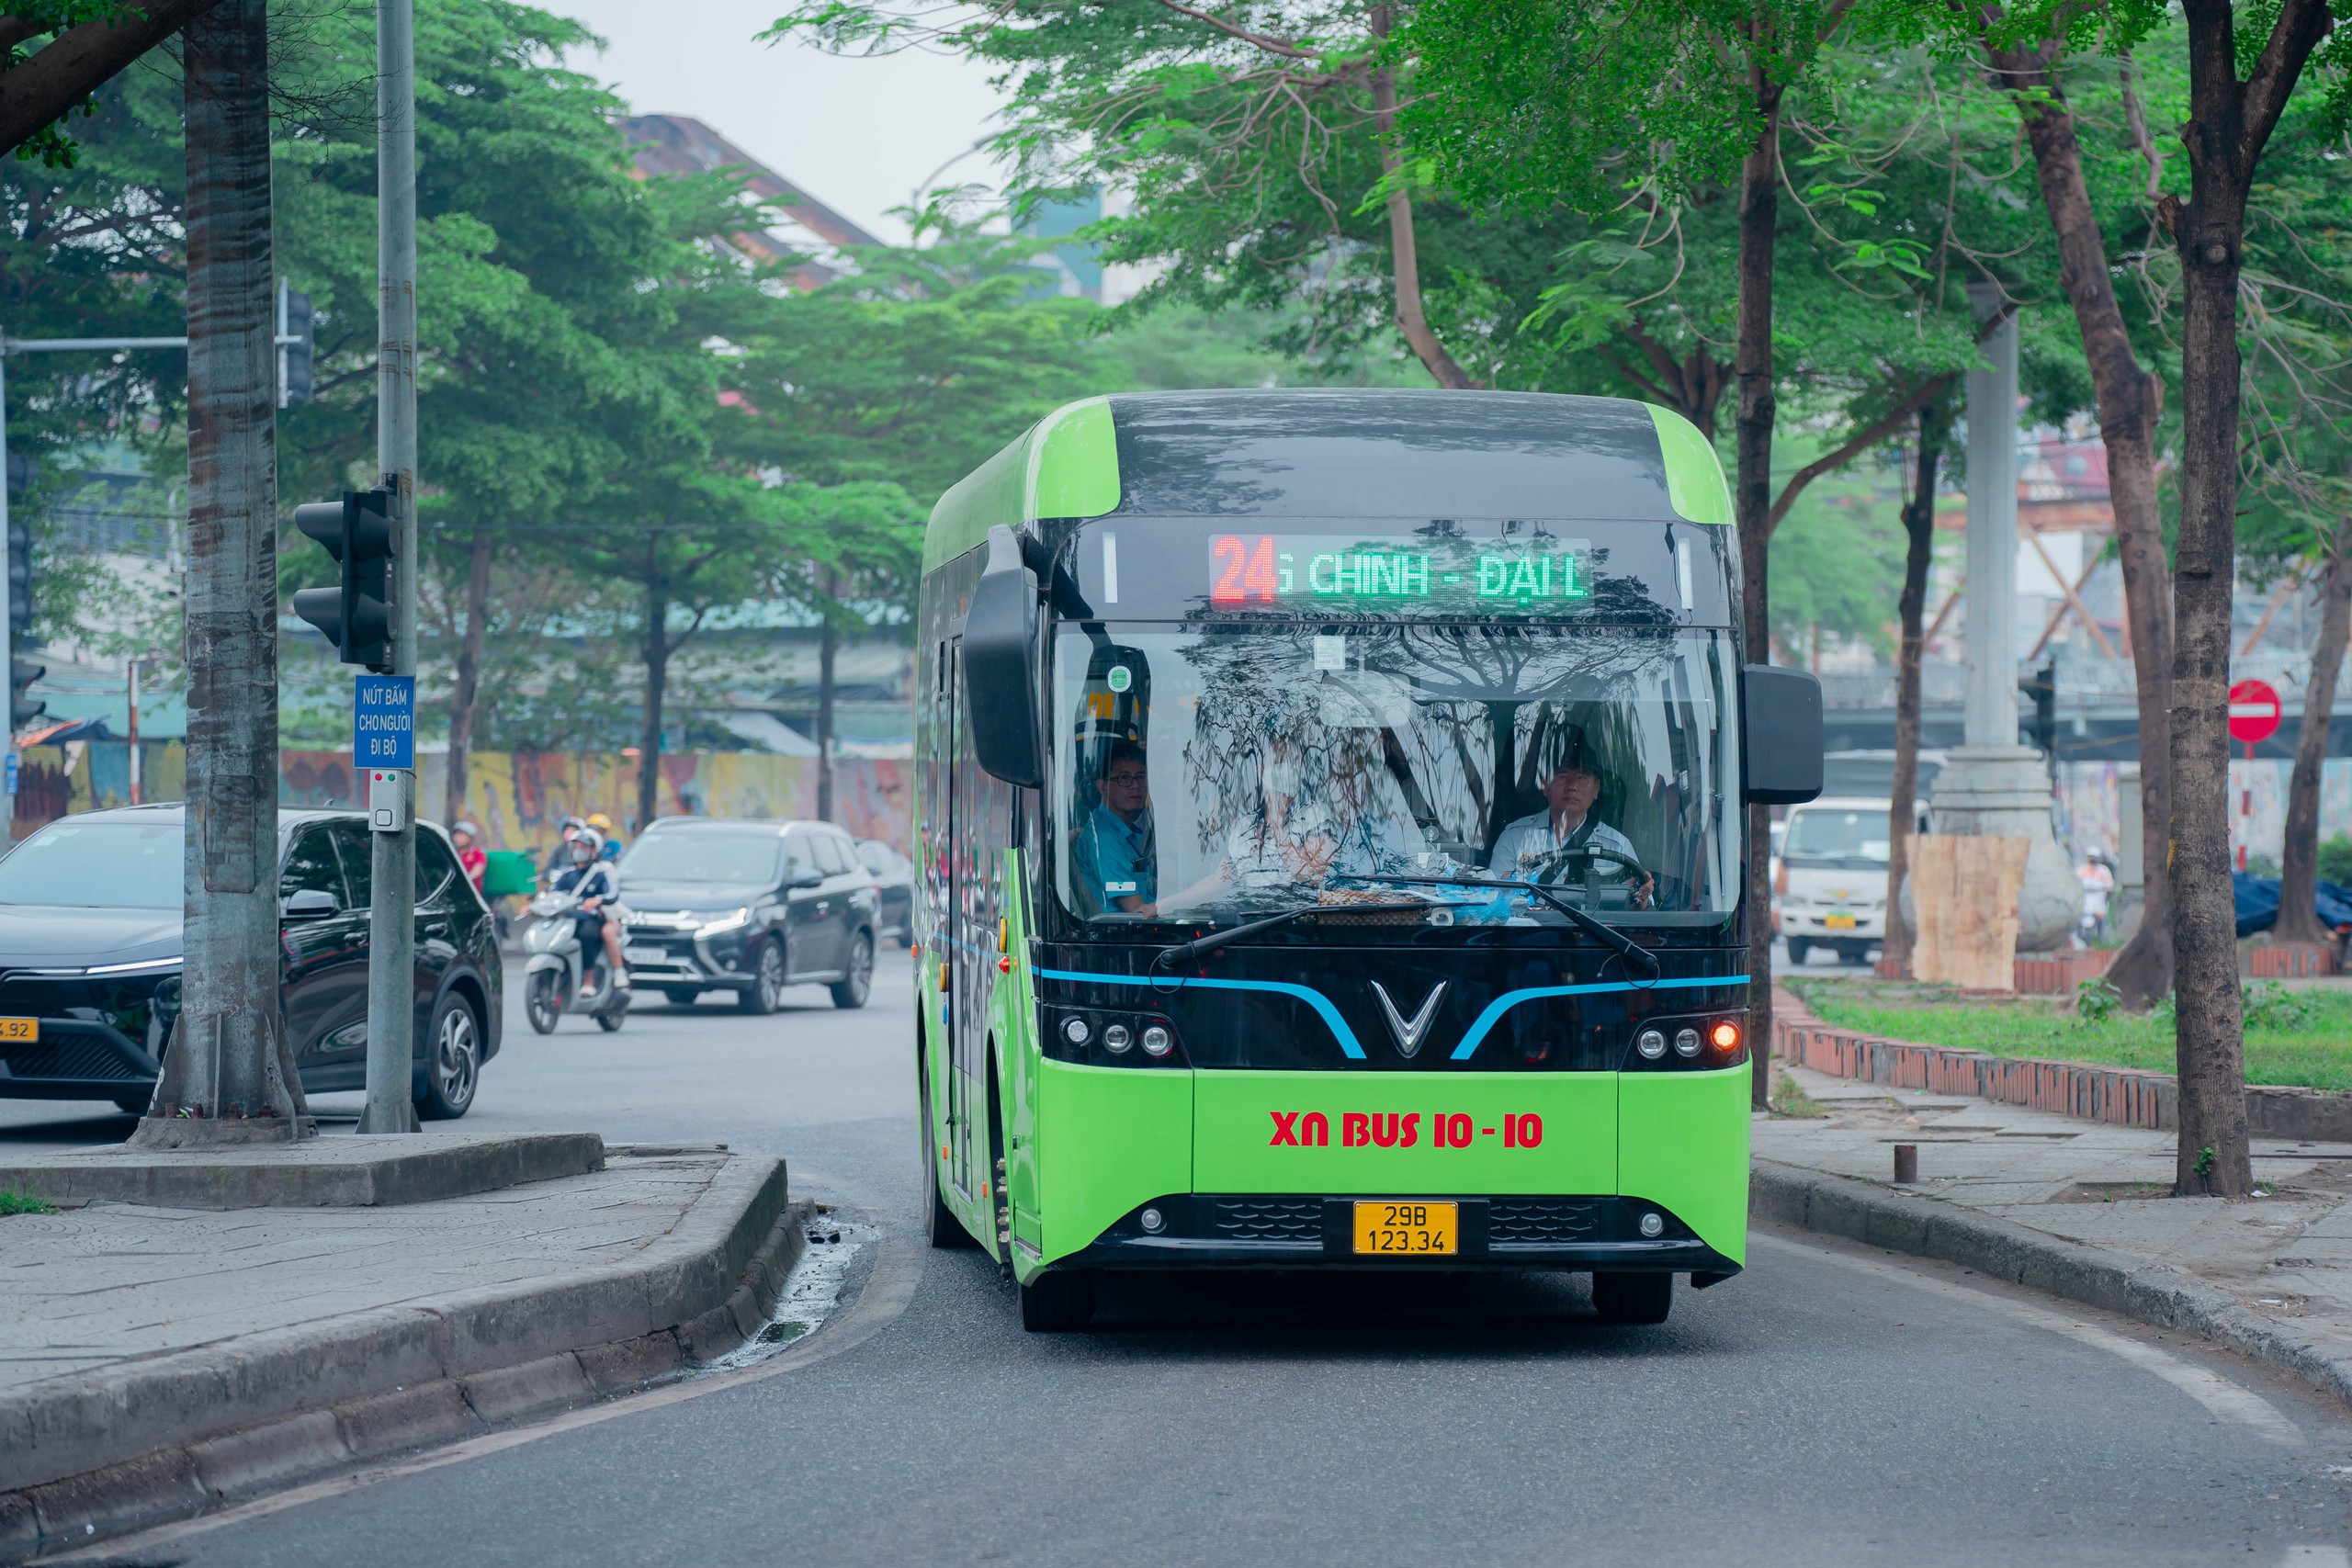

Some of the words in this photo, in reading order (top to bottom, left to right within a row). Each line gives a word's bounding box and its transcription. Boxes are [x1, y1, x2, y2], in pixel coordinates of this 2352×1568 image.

[1215, 537, 1277, 600] 24
[363, 684, 383, 705] NÚT
[385, 684, 407, 705] BẤM
[370, 738, 380, 755] ĐI
[383, 735, 397, 759] BỘ
[1342, 1112, 1420, 1148] BUS
[1384, 1205, 1427, 1226] 29B
[1369, 1230, 1444, 1251] 123.34
